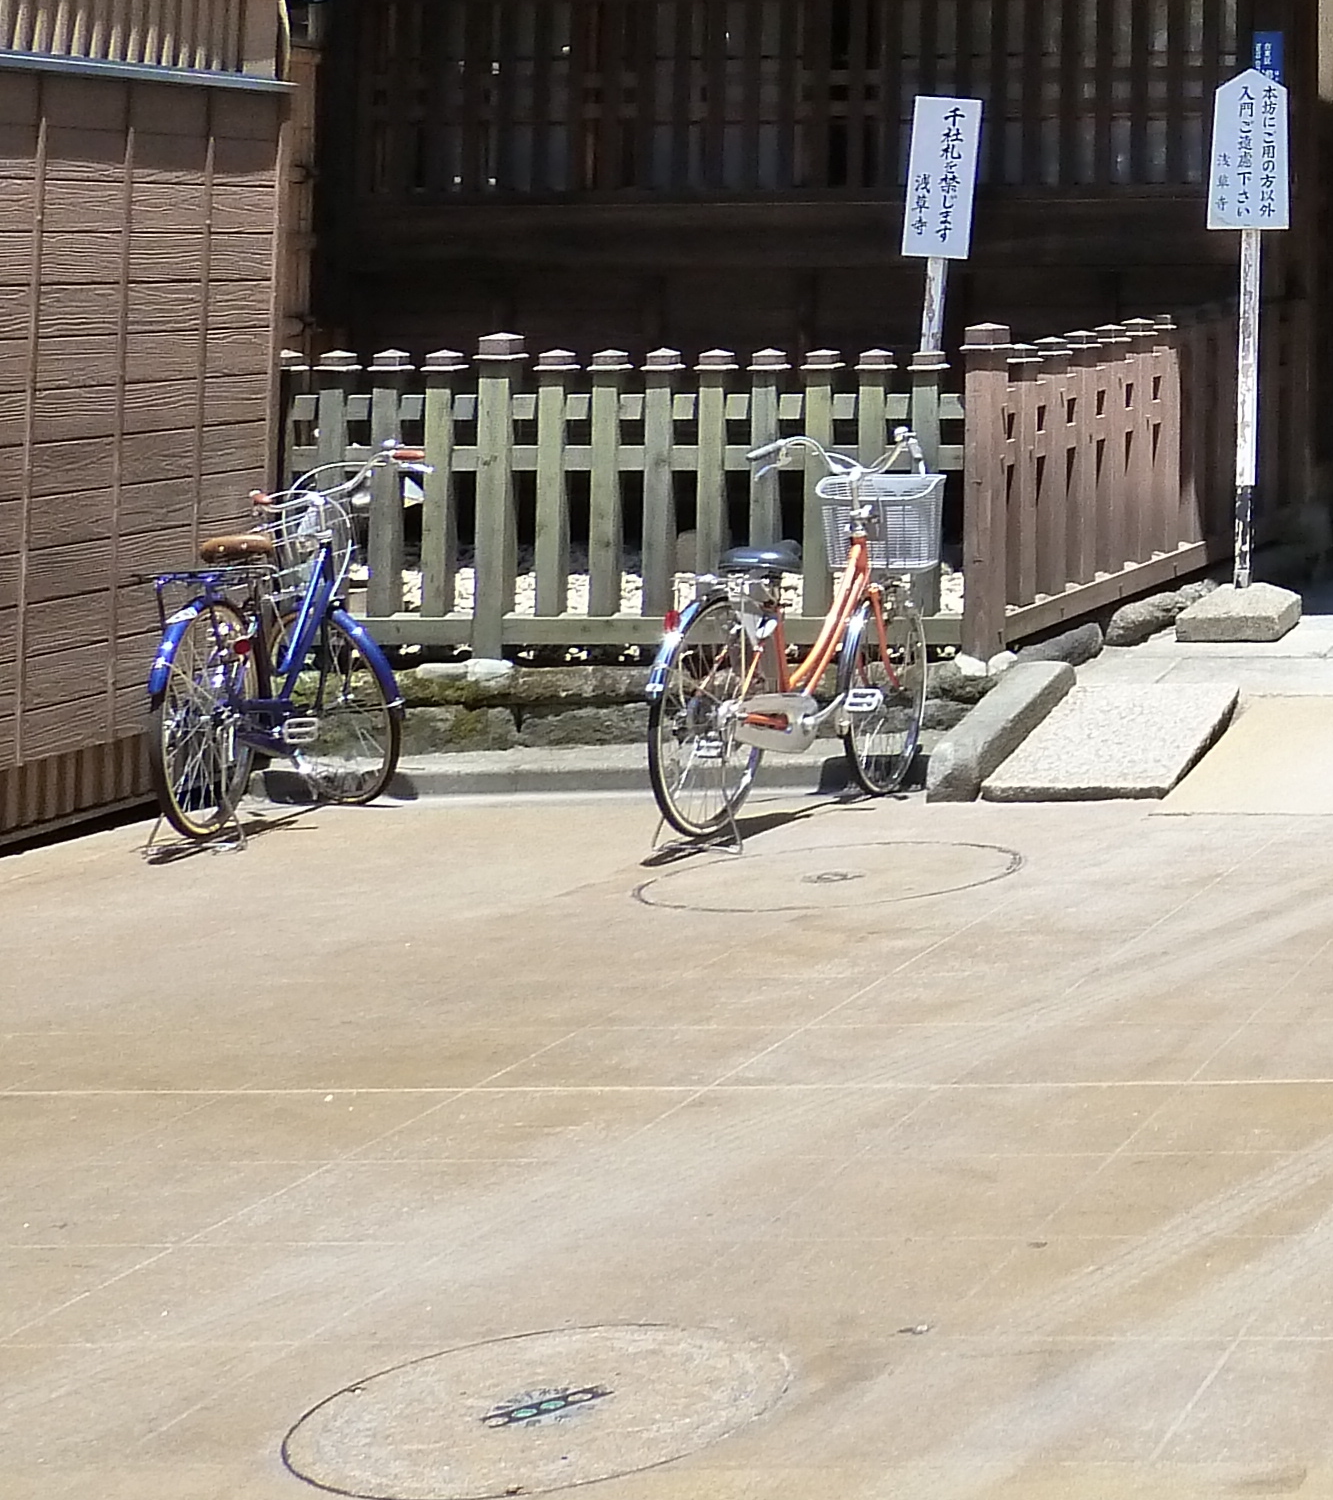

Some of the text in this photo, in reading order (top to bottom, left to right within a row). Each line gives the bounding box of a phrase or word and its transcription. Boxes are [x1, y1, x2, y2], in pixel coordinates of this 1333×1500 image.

[911, 174, 933, 236] 浅草寺
[935, 106, 966, 243] 千社札を禁じます
[1215, 153, 1232, 212] 浅草寺
[1236, 86, 1256, 218] 入門ご遠慮下さい
[1259, 85, 1279, 218] 本坊にご用の方以外
